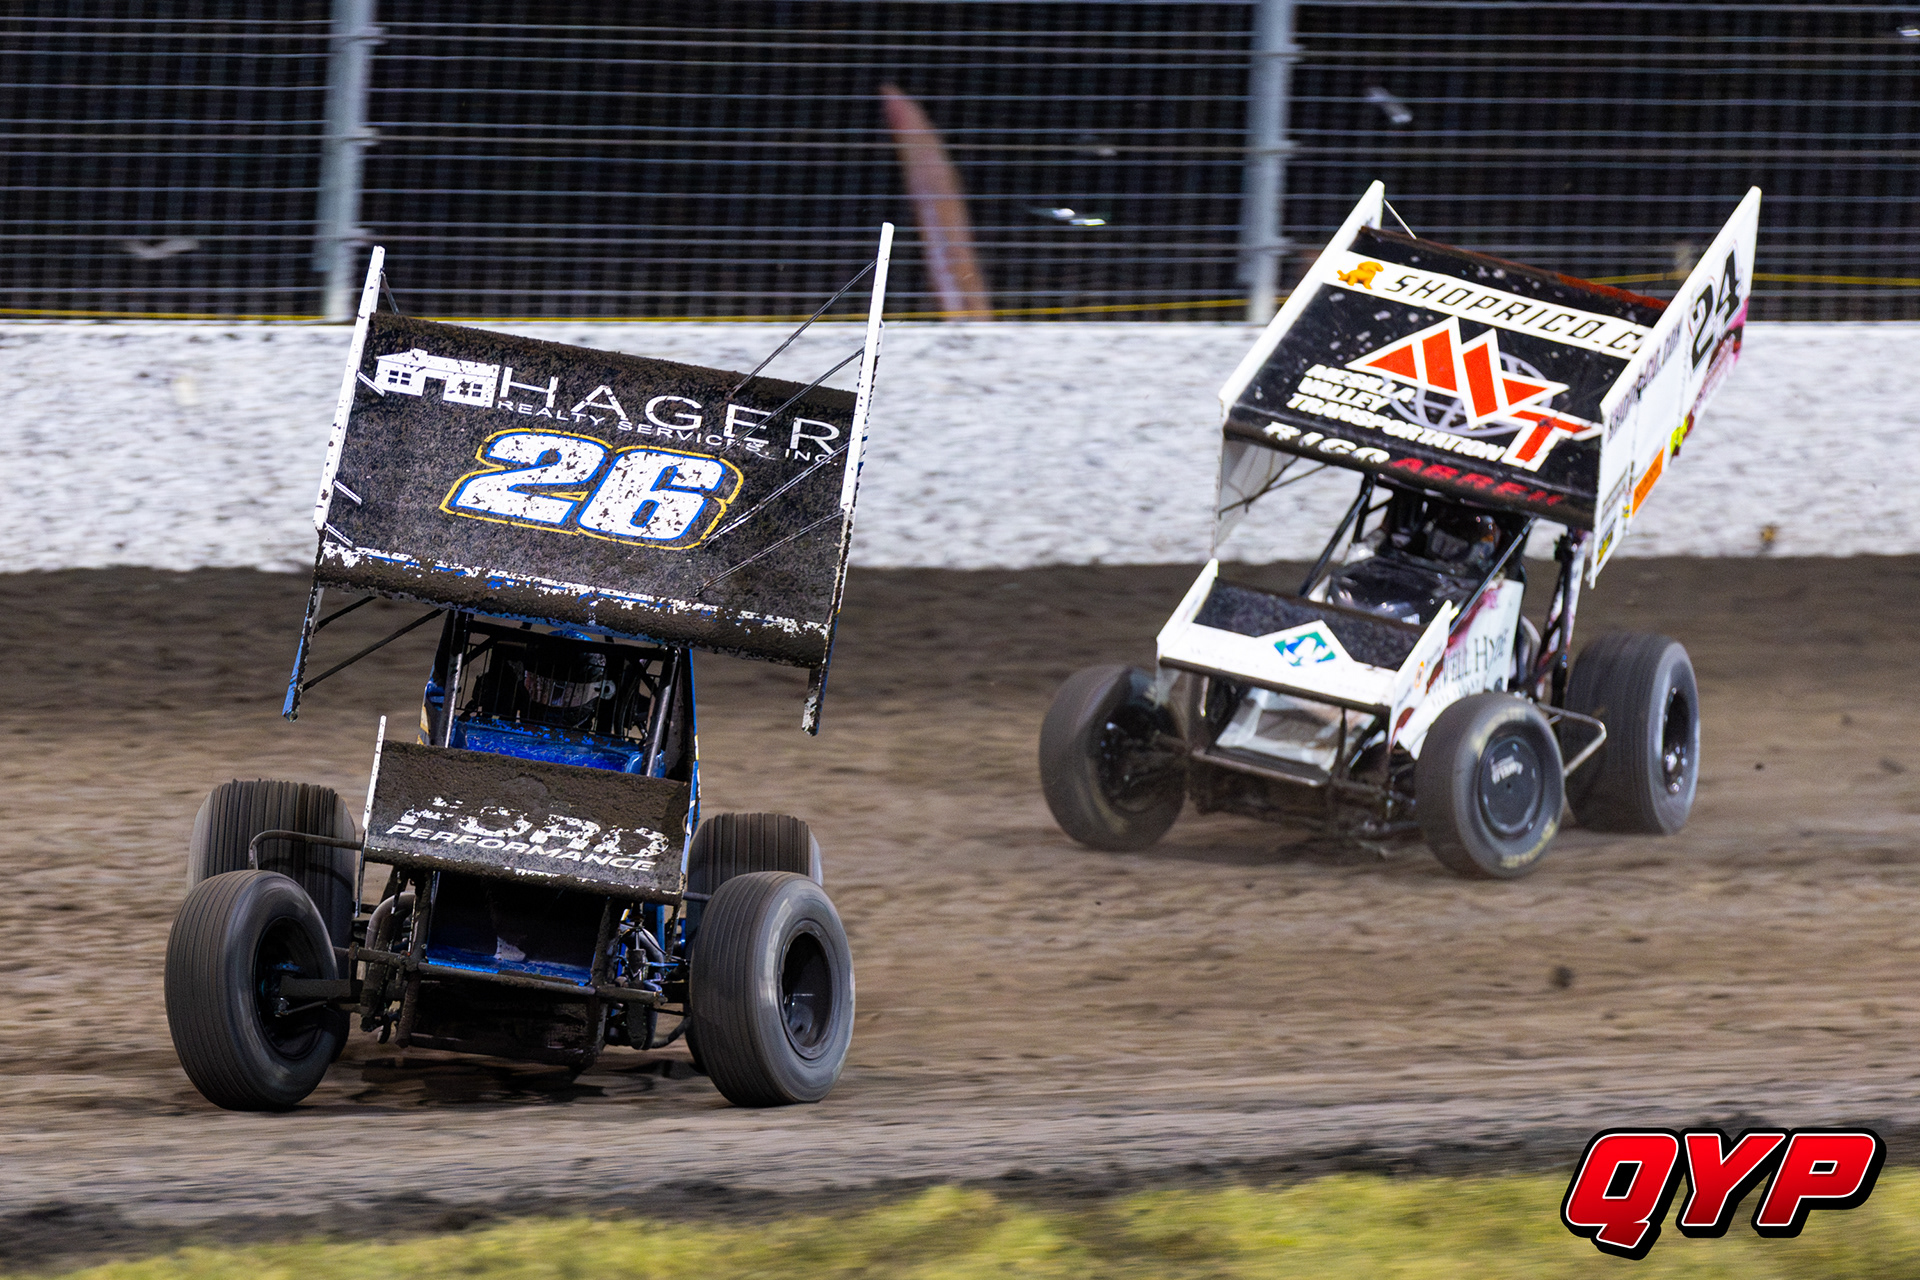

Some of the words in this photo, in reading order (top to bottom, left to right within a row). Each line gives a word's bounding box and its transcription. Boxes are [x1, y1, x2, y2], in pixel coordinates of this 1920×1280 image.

[1690, 246, 1743, 373] 24
[497, 399, 606, 426] REALTY
[500, 366, 841, 456] HAGER
[1297, 377, 1392, 412] VALLEY
[1286, 393, 1508, 462] TRANSPORTATION
[443, 430, 738, 546] 26
[386, 824, 657, 872] PERFORMANCE
[398, 797, 670, 858] FORD
